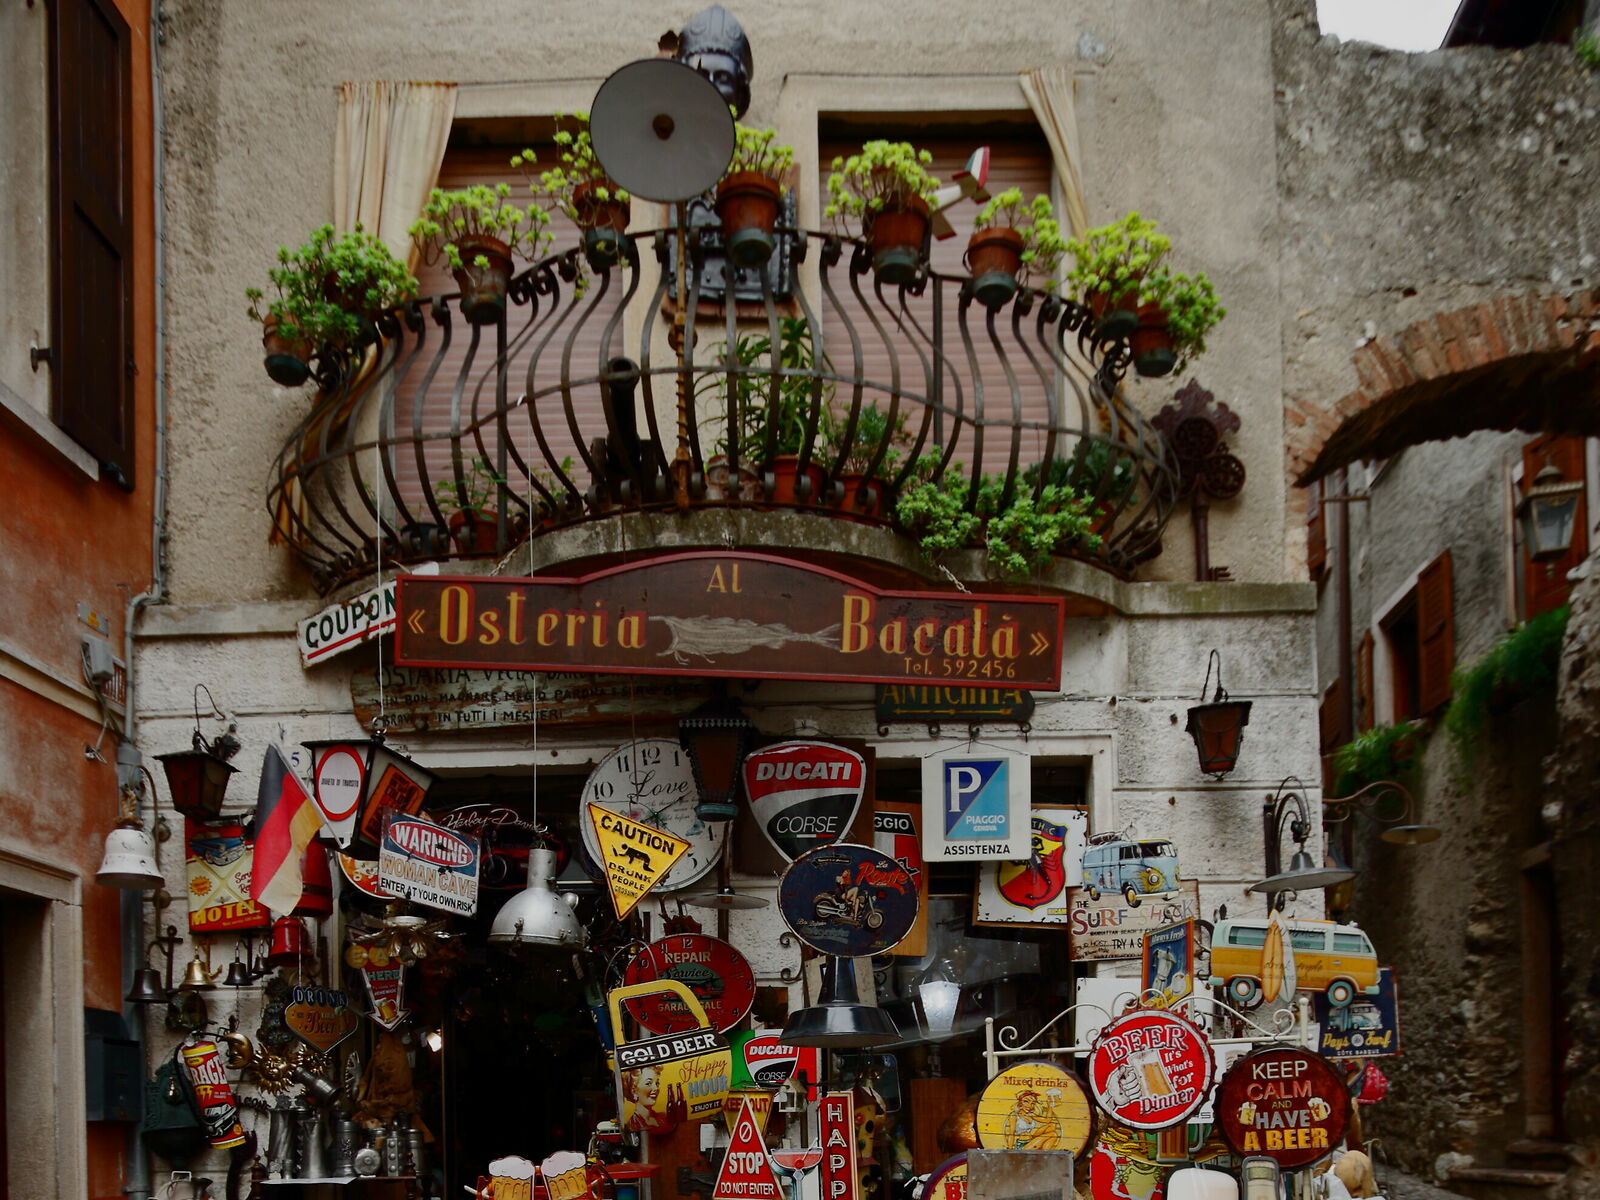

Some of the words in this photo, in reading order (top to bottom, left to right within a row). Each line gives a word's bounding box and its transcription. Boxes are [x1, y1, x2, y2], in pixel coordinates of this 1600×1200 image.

[706, 564, 742, 593] Al
[440, 585, 645, 648] Osteria
[904, 657, 932, 676] Tel.
[943, 659, 1015, 679] 592456
[457, 709, 486, 721] TUTTI
[618, 755, 629, 772] 11
[642, 747, 660, 767] 12
[756, 761, 852, 782] DUCATI
[594, 781, 613, 799] 10
[627, 770, 688, 800] Love
[949, 767, 982, 812] P
[776, 815, 838, 835] CORSE
[965, 814, 1005, 824] PIAGGIO
[395, 824, 469, 865] WARNING
[601, 815, 675, 855] CAUTION
[944, 844, 1010, 855] ASSISTENZA
[382, 854, 436, 888] WOMAN
[439, 873, 477, 899] CAVE
[608, 861, 652, 883] DRUNK
[612, 873, 645, 891] PEOPLE
[381, 877, 404, 894] ENTER
[405, 885, 417, 896] AT
[418, 889, 437, 907] YOUR
[439, 895, 456, 910] OWN
[457, 901, 473, 914] RISK
[1075, 901, 1089, 909] THE
[191, 900, 261, 926] MOTEL
[1073, 908, 1128, 935] SURF
[1112, 939, 1126, 949] TRY
[665, 951, 711, 963] REPAIR
[672, 1033, 718, 1055] BEER
[749, 1046, 794, 1056] DUCATI
[1102, 1024, 1189, 1064] BEER
[1165, 1050, 1182, 1063] It's
[679, 1057, 728, 1084] Happy
[757, 1071, 786, 1081] CORSE
[1164, 1060, 1194, 1075] What's
[1251, 1060, 1308, 1081] KEEP
[687, 1075, 728, 1099] HOUR
[1003, 1076, 1033, 1087] Mixed
[1035, 1077, 1068, 1088] drinks
[1172, 1071, 1194, 1089] for
[1247, 1080, 1312, 1101] CALM
[695, 1104, 712, 1112] ENJOY
[1139, 1087, 1196, 1115] Dinner
[1271, 1101, 1292, 1109] AND
[1254, 1109, 1311, 1130] HAVE
[1243, 1130, 1261, 1151] A
[1265, 1127, 1329, 1150] BEER
[728, 1152, 764, 1175] STOP
[720, 1184, 732, 1193] DO
[732, 1184, 748, 1194] NOT
[749, 1184, 775, 1195] ENTER
